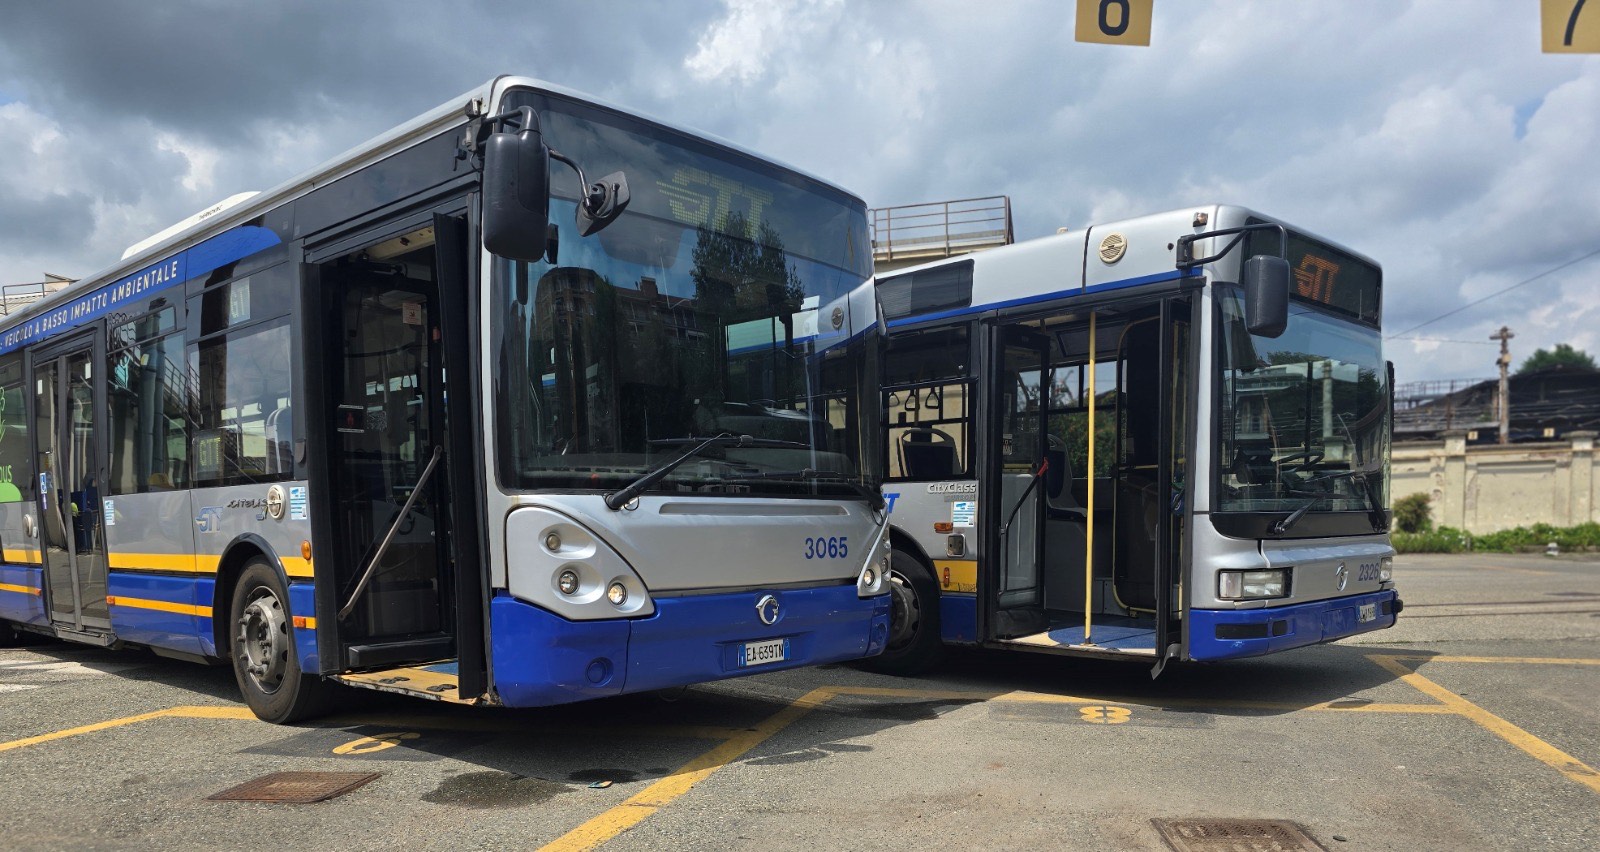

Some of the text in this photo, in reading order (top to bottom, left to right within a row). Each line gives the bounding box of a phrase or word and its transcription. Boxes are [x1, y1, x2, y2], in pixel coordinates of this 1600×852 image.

[656, 165, 774, 240] GTT
[1293, 253, 1340, 304] GTT
[5, 261, 178, 347] VEICOLO A BASSO IMPATTO AMBIENTALE
[927, 483, 976, 495] CityClass
[804, 536, 848, 560] 3065
[1358, 562, 1380, 582] 2326
[1079, 705, 1132, 725] 8
